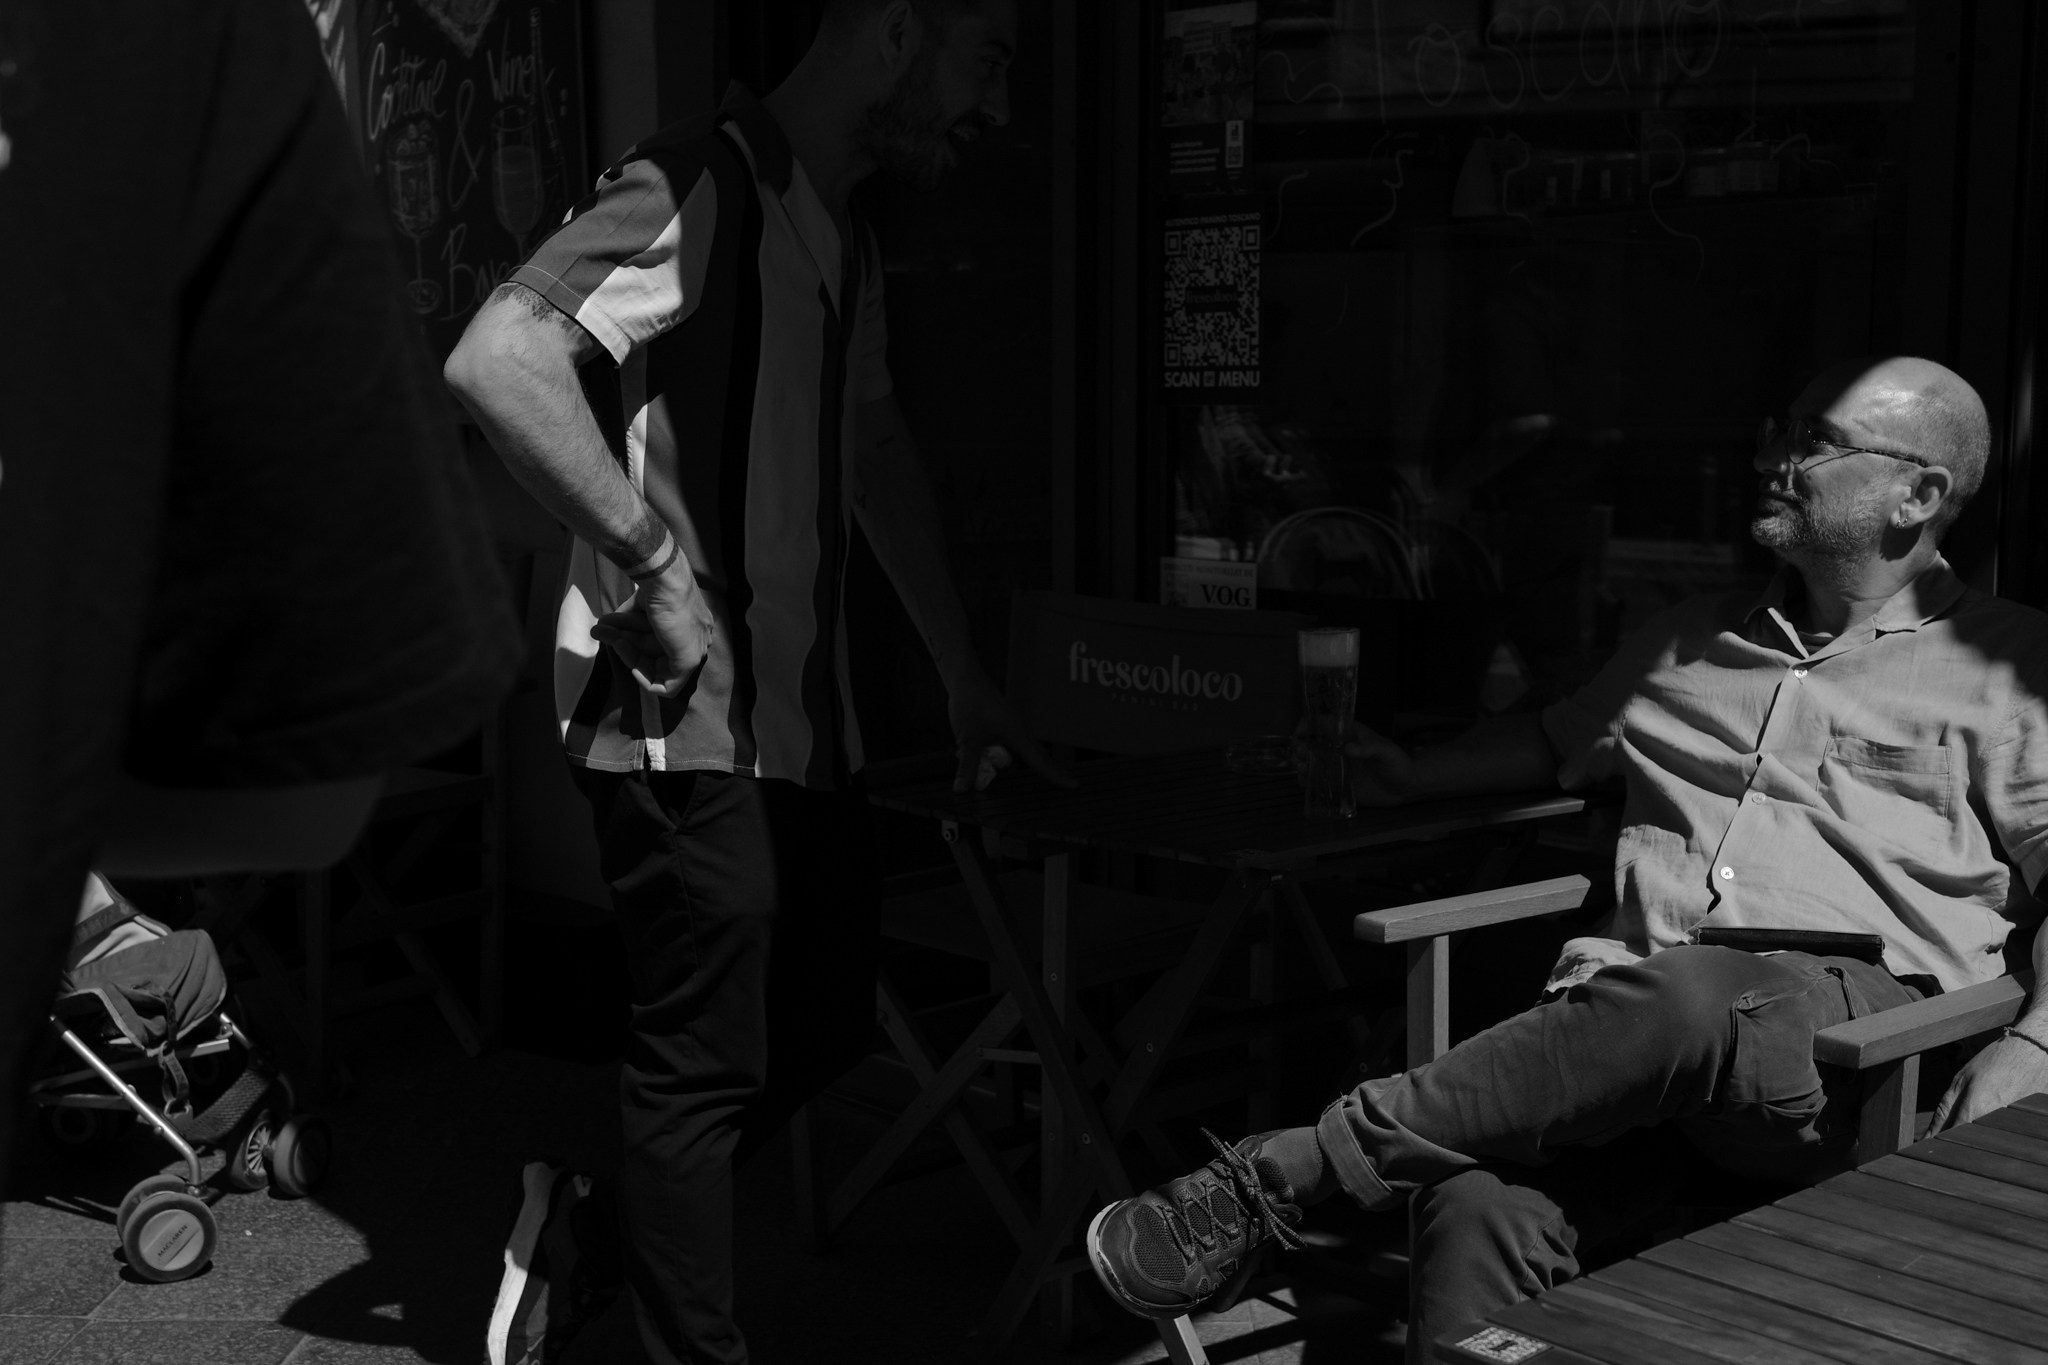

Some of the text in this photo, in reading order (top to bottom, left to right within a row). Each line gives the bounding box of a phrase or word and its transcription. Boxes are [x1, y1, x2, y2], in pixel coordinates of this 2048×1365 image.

[447, 79, 484, 212] &
[1228, 212, 1261, 222] TOSCANO
[1163, 370, 1261, 388] SCAN MENU
[1068, 640, 1243, 702] frescoloco
[157, 1224, 188, 1257] MACLAREN
